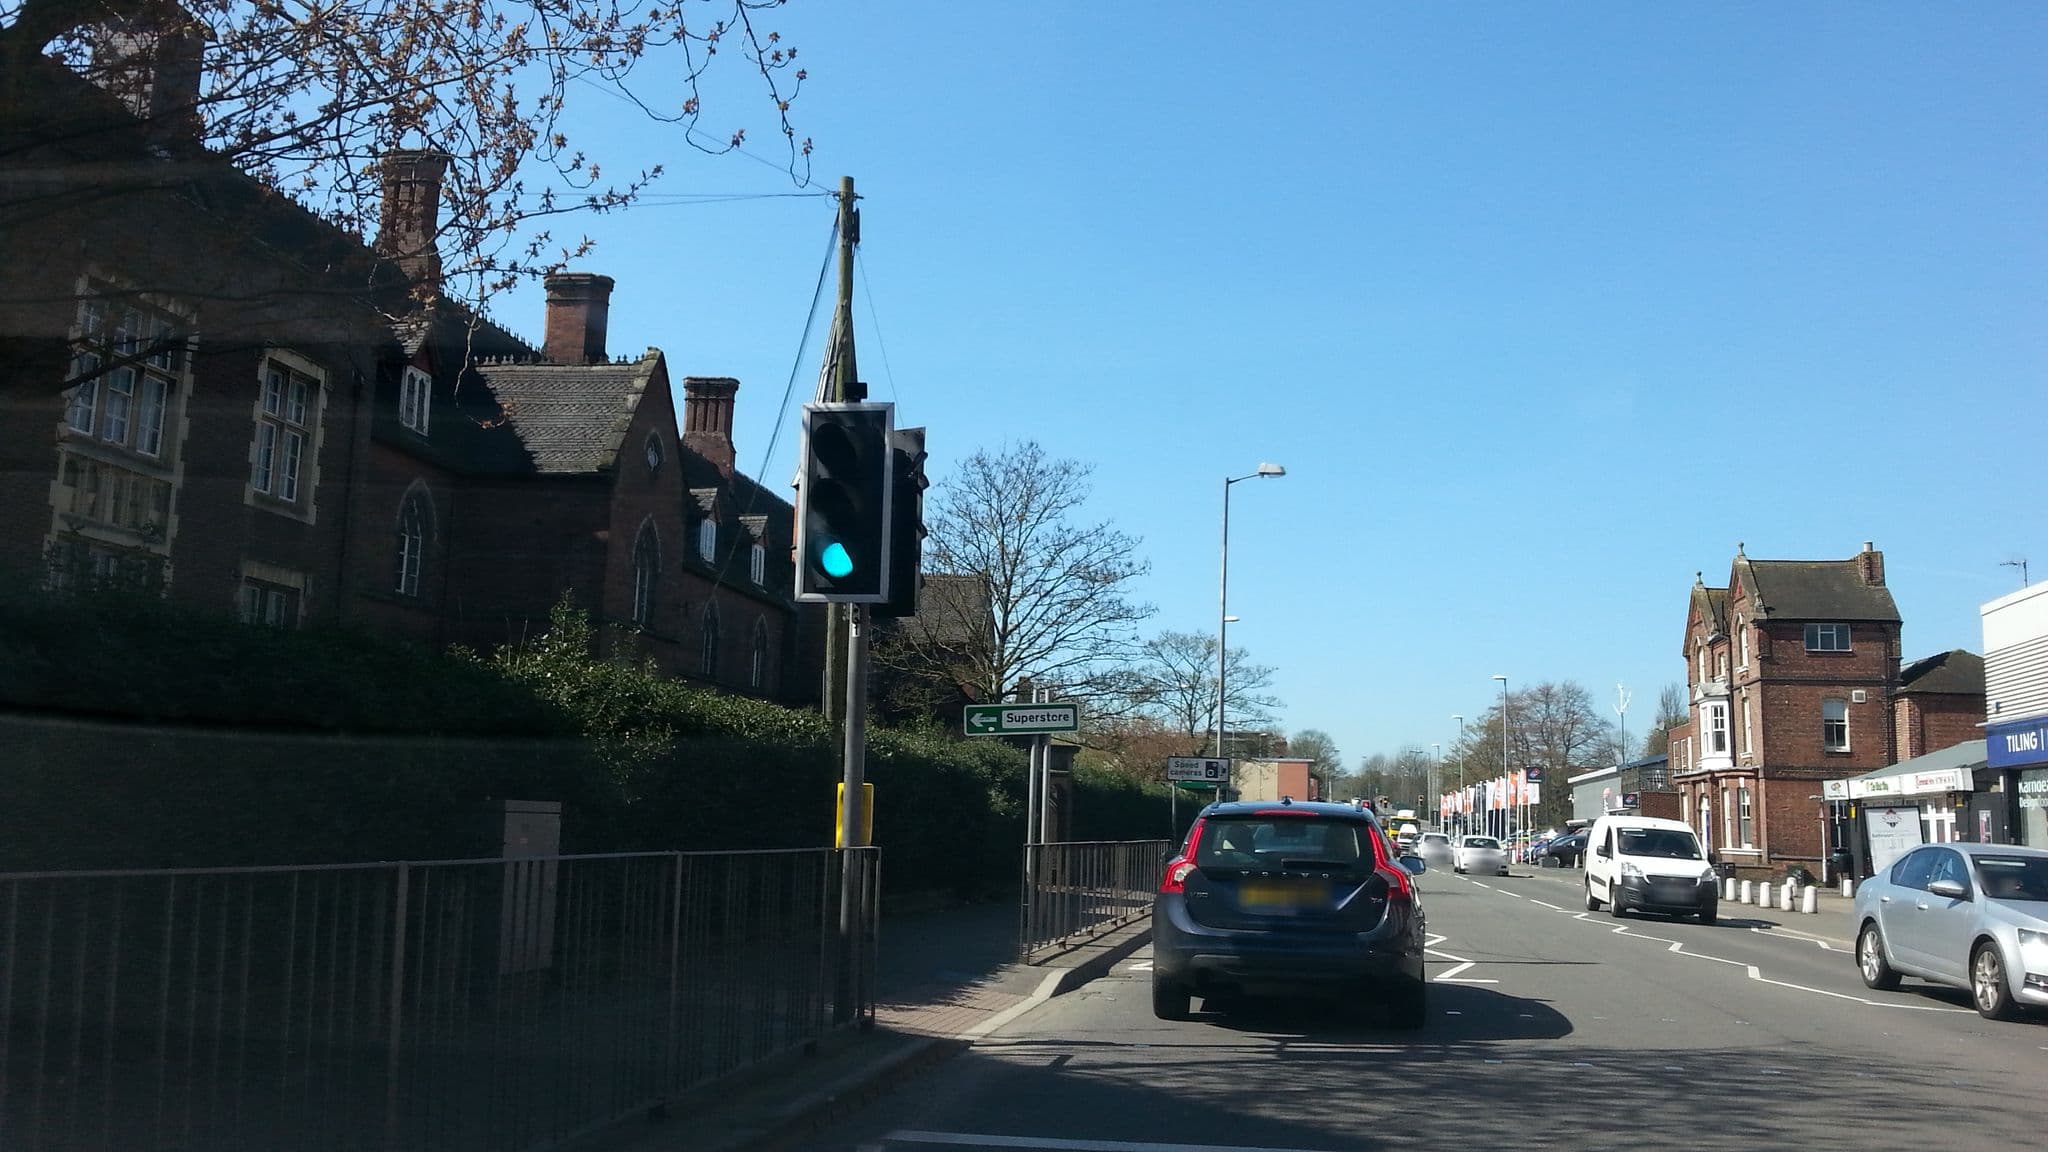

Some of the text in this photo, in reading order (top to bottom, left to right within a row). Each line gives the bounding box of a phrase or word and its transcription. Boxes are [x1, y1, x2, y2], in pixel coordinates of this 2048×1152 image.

[1006, 712, 1070, 724] Superstore
[2006, 732, 2038, 752] TILING
[1174, 760, 1199, 769] Speed
[1170, 769, 1202, 777] cameras
